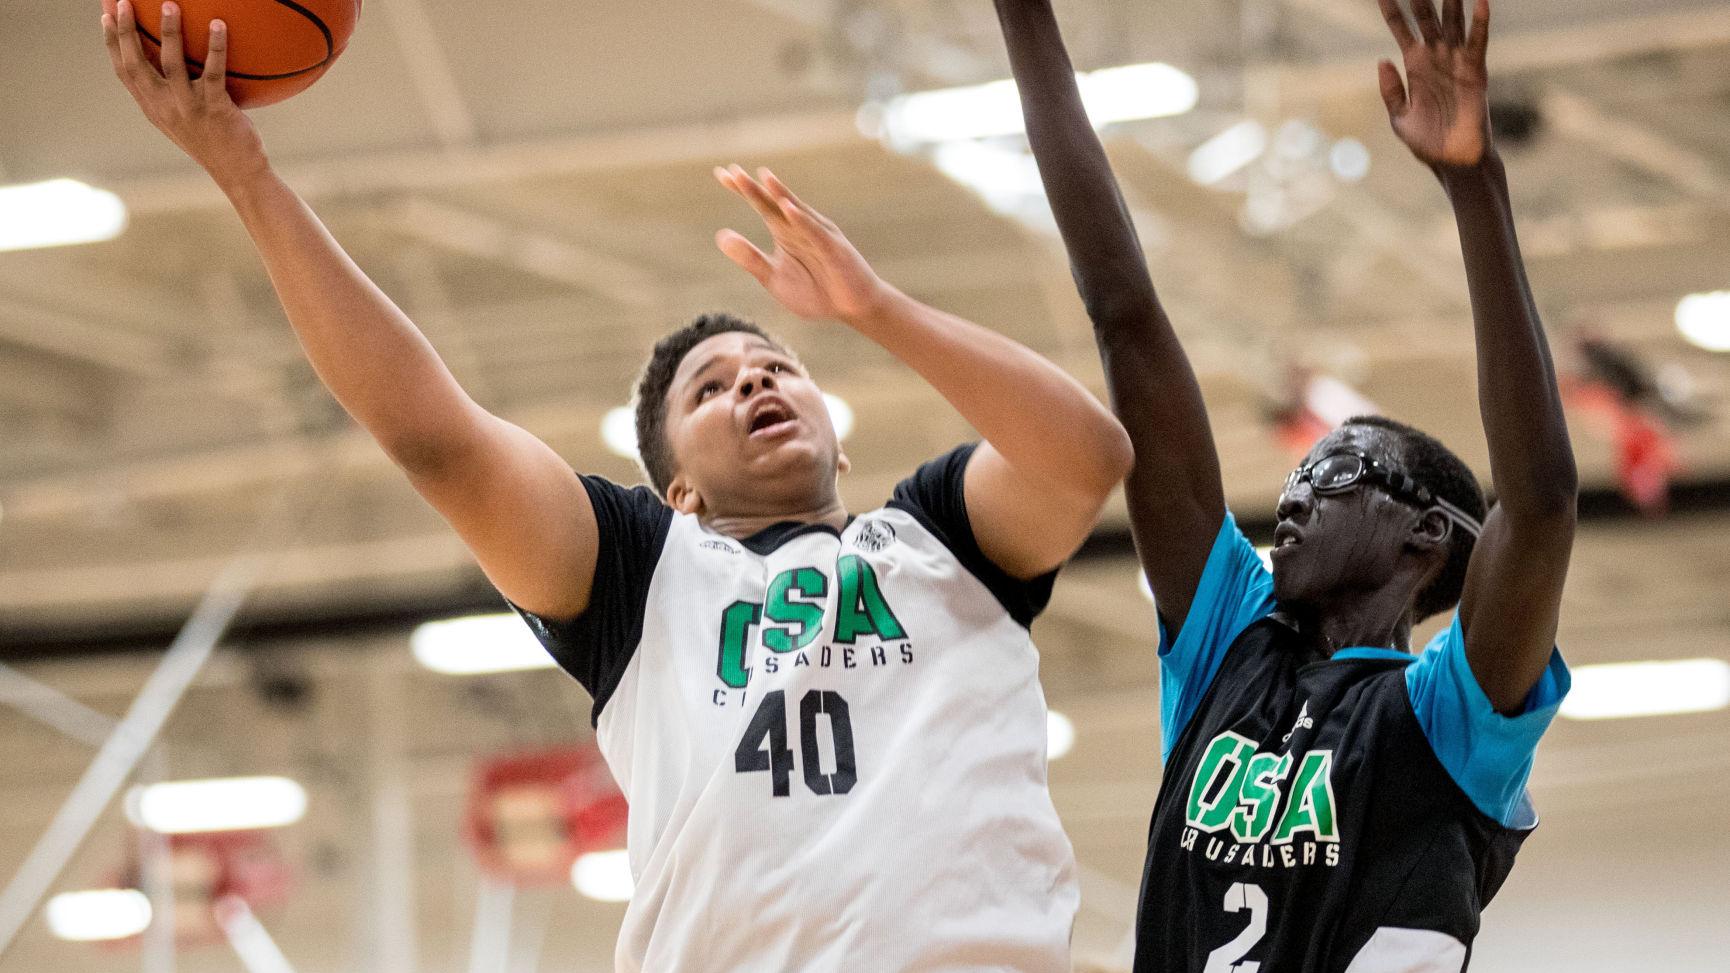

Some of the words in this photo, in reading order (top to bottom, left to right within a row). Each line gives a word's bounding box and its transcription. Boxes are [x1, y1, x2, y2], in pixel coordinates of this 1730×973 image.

[712, 643, 914, 707] CSADERS
[734, 689, 858, 797] 40
[1186, 730, 1340, 845] OSA
[1180, 826, 1340, 868] CRUSADERS
[1203, 881, 1269, 973] 2
